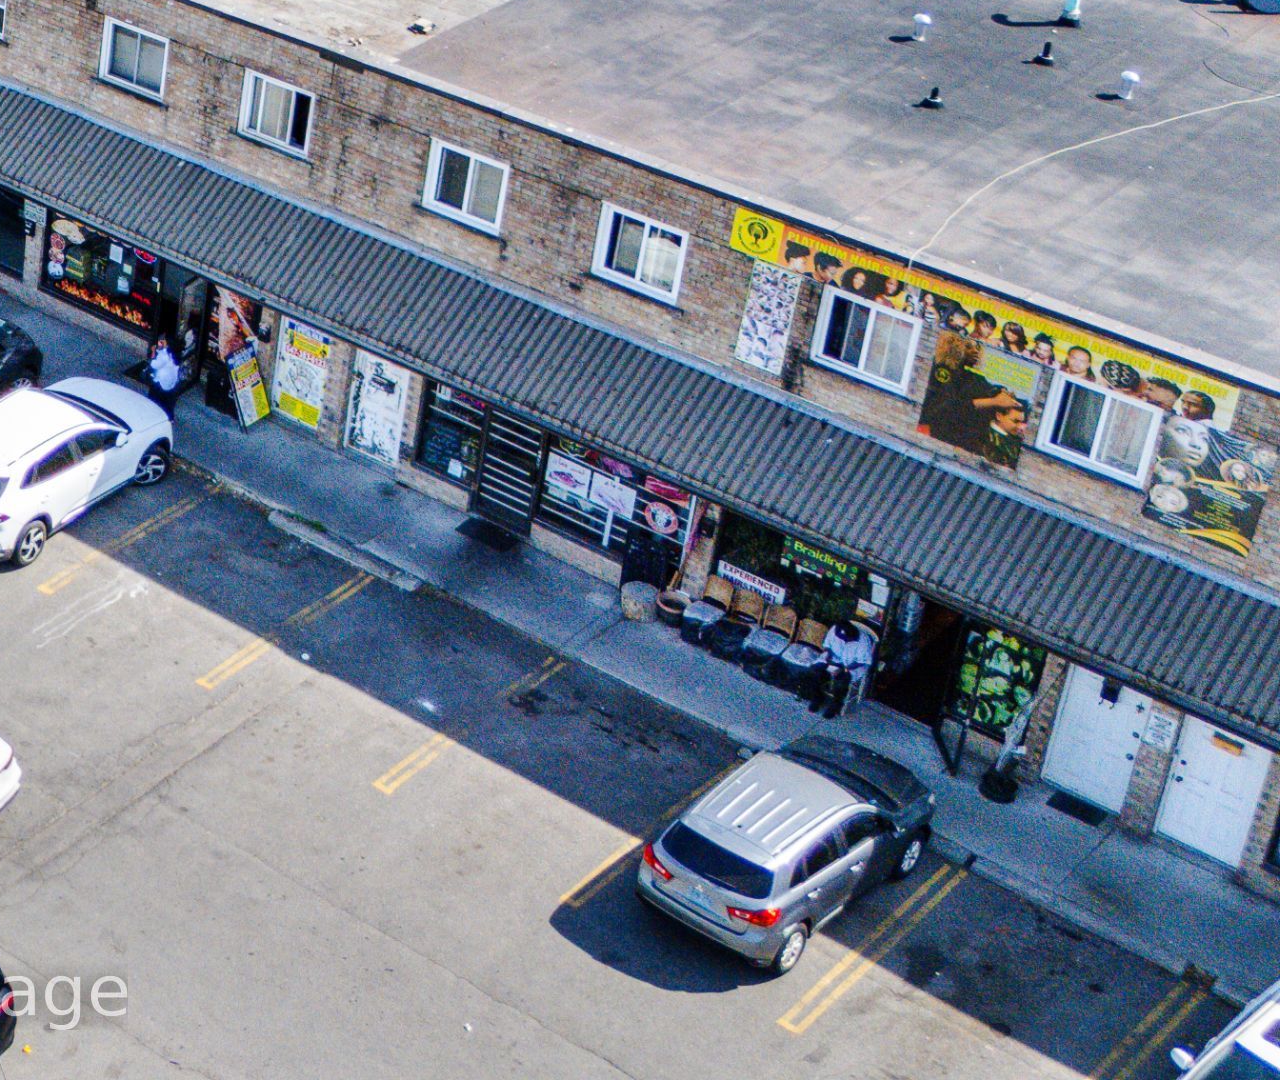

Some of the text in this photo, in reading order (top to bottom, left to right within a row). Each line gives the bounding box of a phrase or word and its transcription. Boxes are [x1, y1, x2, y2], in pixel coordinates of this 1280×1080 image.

[787, 231, 847, 261] PLATINUM
[849, 252, 881, 272] HAIR
[883, 264, 930, 288] STUDIO
[944, 288, 995, 313] SCHOOL
[1090, 340, 1152, 370] AFRICAN
[1152, 363, 1188, 385] HAIR
[1191, 377, 1230, 399] CARE
[793, 539, 847, 573] Braiding
[723, 563, 780, 595] EXPERIENCED
